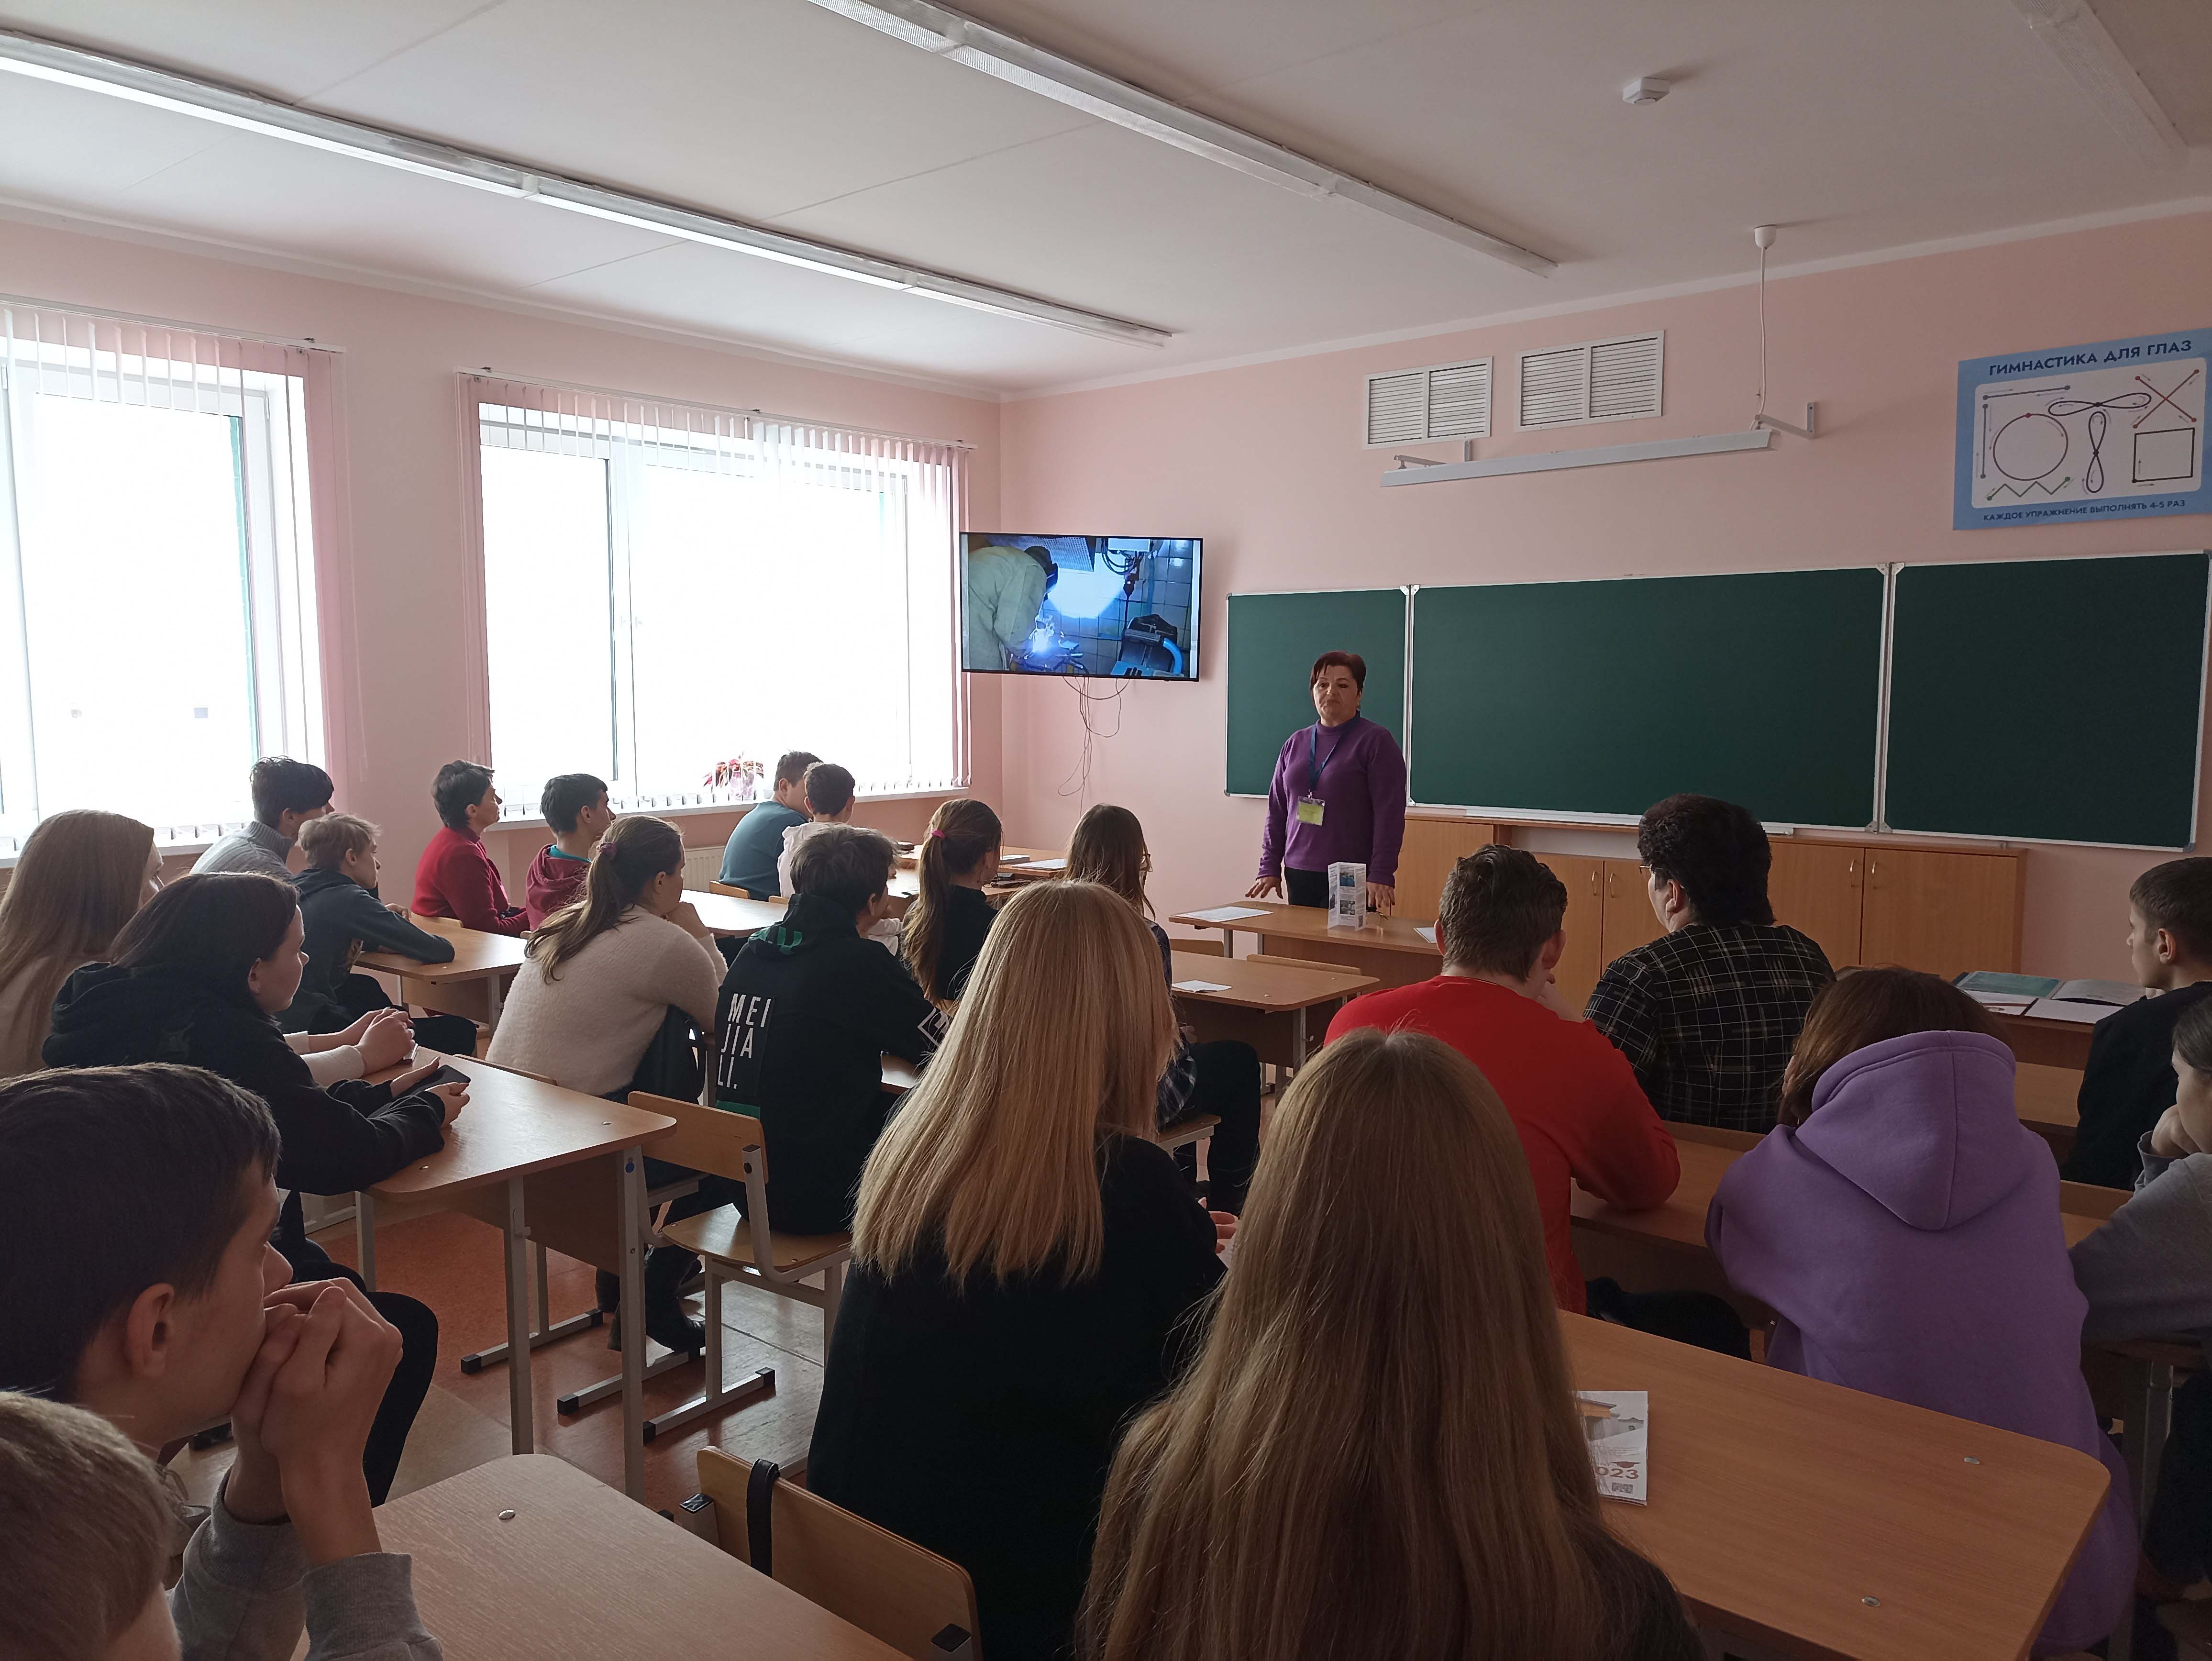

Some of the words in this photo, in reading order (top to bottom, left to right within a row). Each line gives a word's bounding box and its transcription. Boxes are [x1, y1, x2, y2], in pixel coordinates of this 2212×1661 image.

[1989, 353, 2098, 376] ГИМНАСТИКА
[2103, 346, 2141, 363] ДЛЯ
[2147, 340, 2192, 355] ГЛАЗ
[1983, 511, 2023, 521] КАЖДОЕ
[2025, 507, 2088, 518] УПРАЖНЕНИЕ
[2090, 503, 2147, 514] ВЫПОЛНЯТЬ
[2167, 499, 2186, 508] РАЗ
[727, 993, 772, 1028] MEI
[720, 1023, 754, 1059] JIA
[717, 1054, 737, 1089] LI.
[1594, 1466, 1639, 1479] 023
